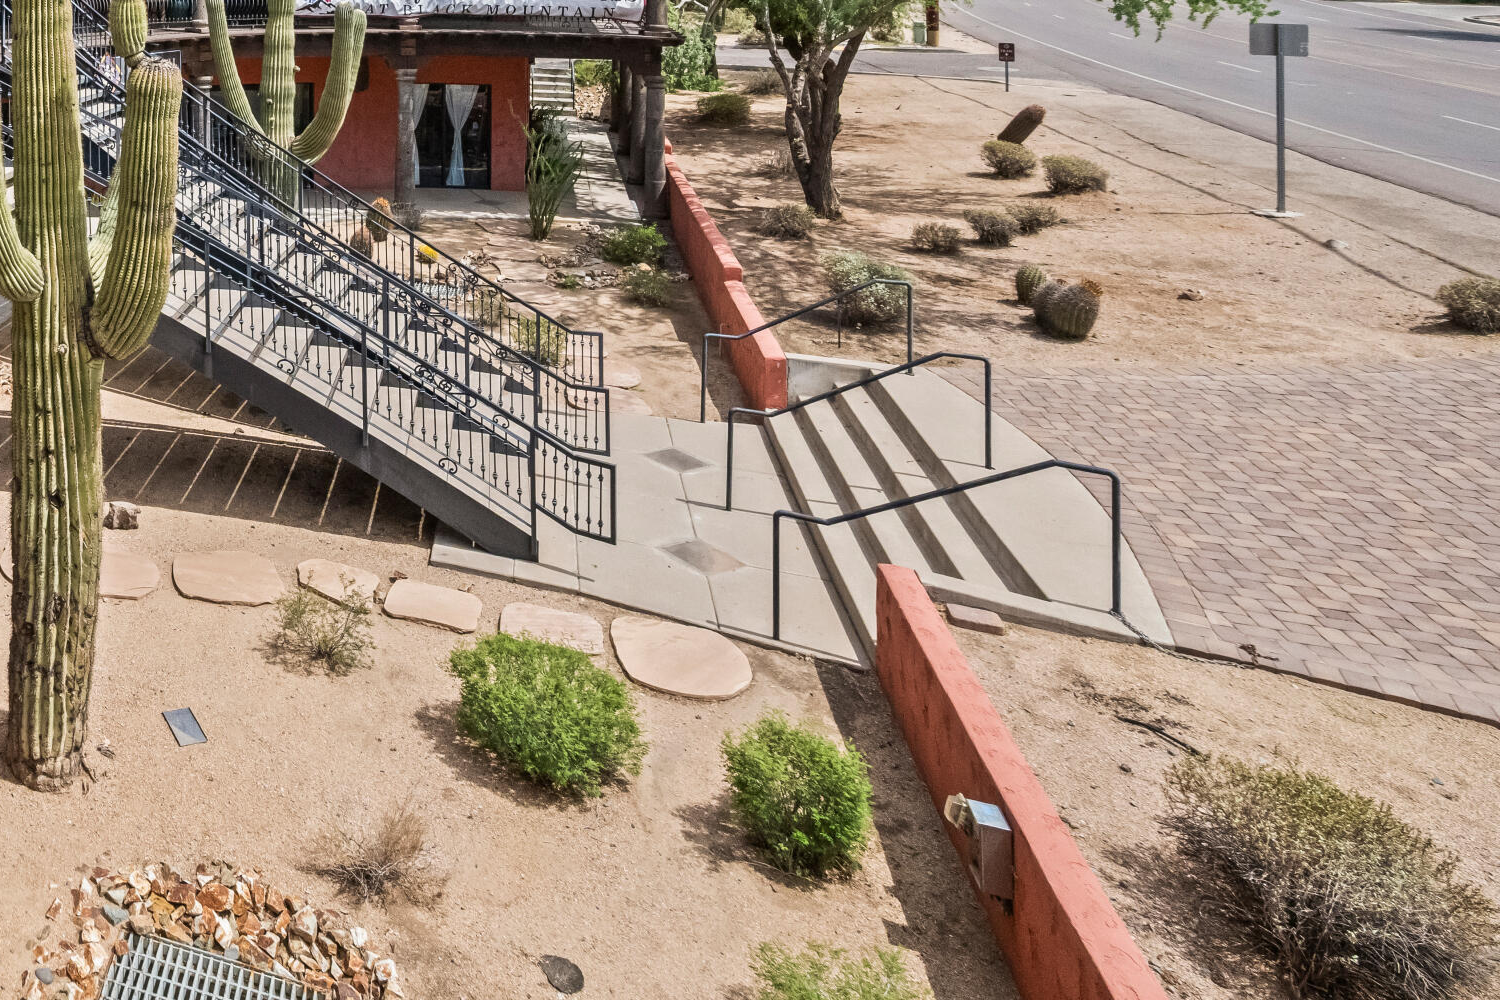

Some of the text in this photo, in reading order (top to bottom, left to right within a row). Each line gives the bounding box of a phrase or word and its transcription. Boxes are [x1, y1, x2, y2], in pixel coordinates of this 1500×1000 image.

[365, 3, 616, 18] AT BLACK MOUNTAIN
